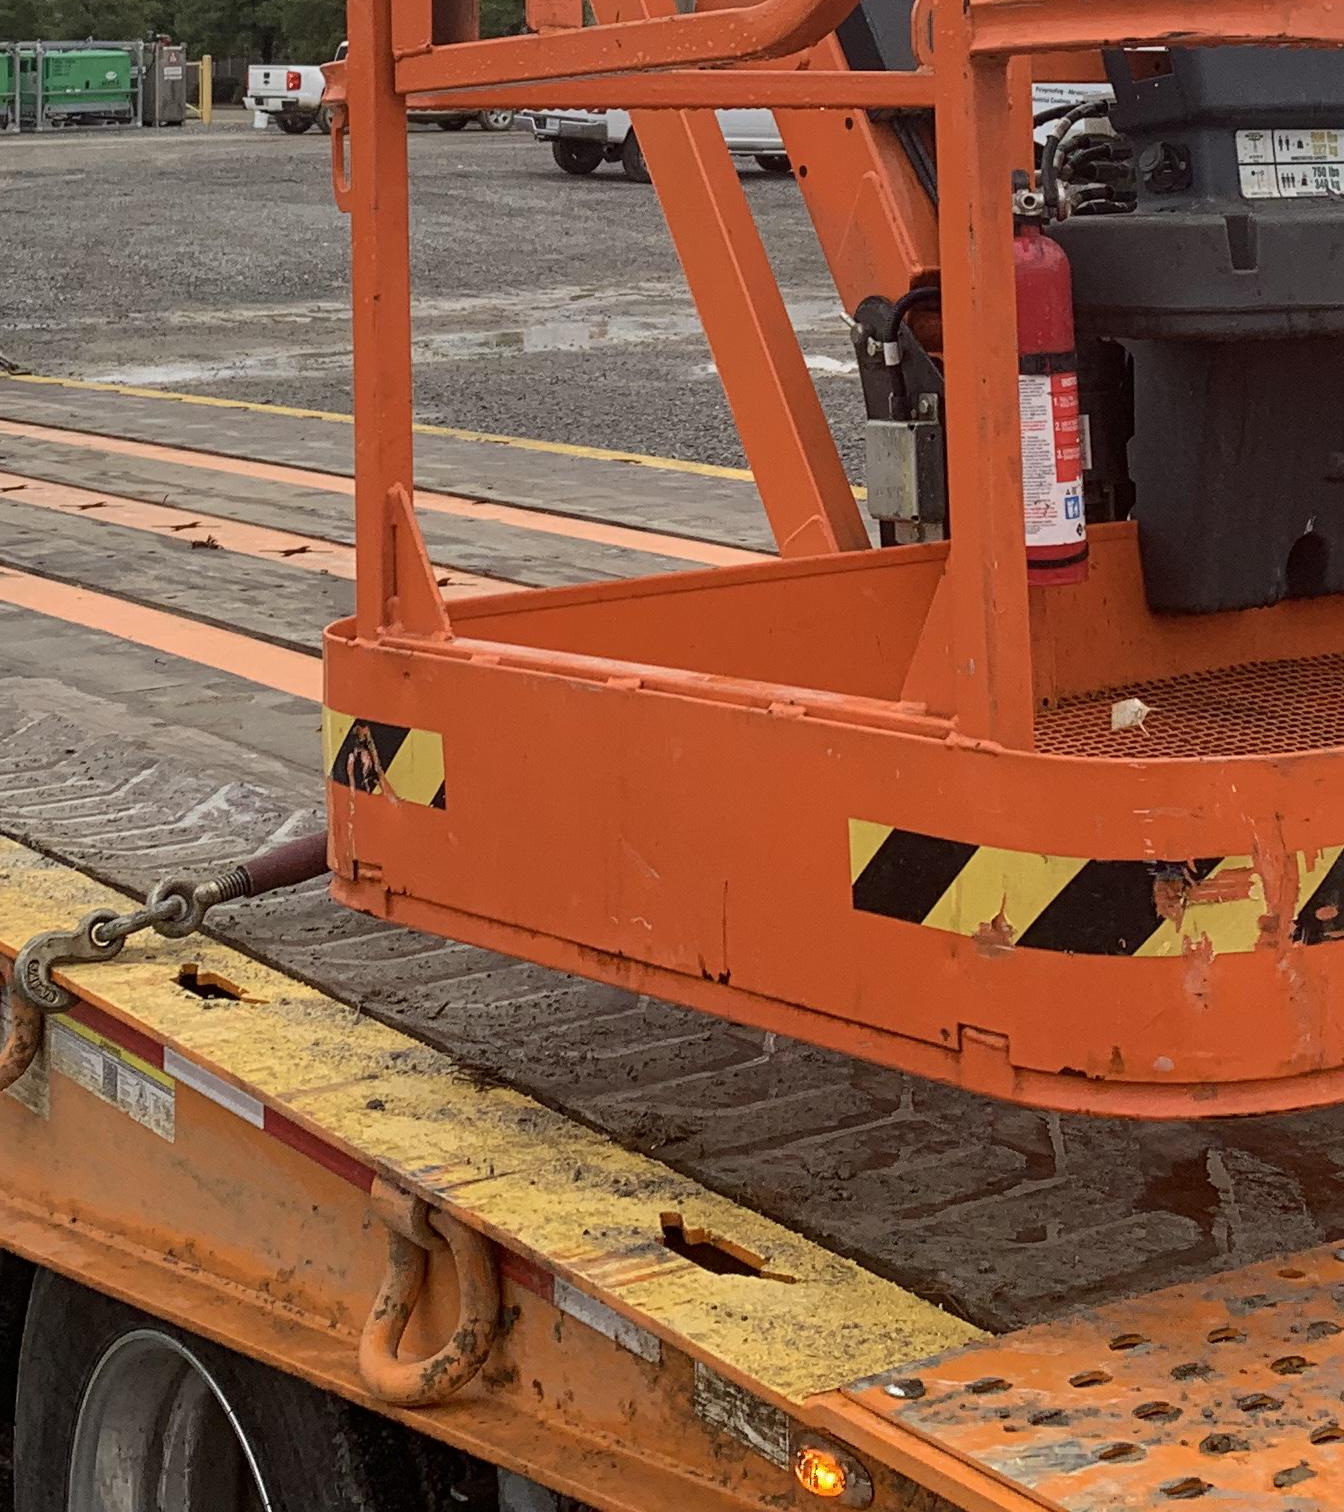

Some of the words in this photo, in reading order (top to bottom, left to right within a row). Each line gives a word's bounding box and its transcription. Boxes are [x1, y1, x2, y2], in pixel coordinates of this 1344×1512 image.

[1312, 166, 1327, 178] 750
[1328, 166, 1340, 178] lbs
[1330, 178, 1341, 191] kg
